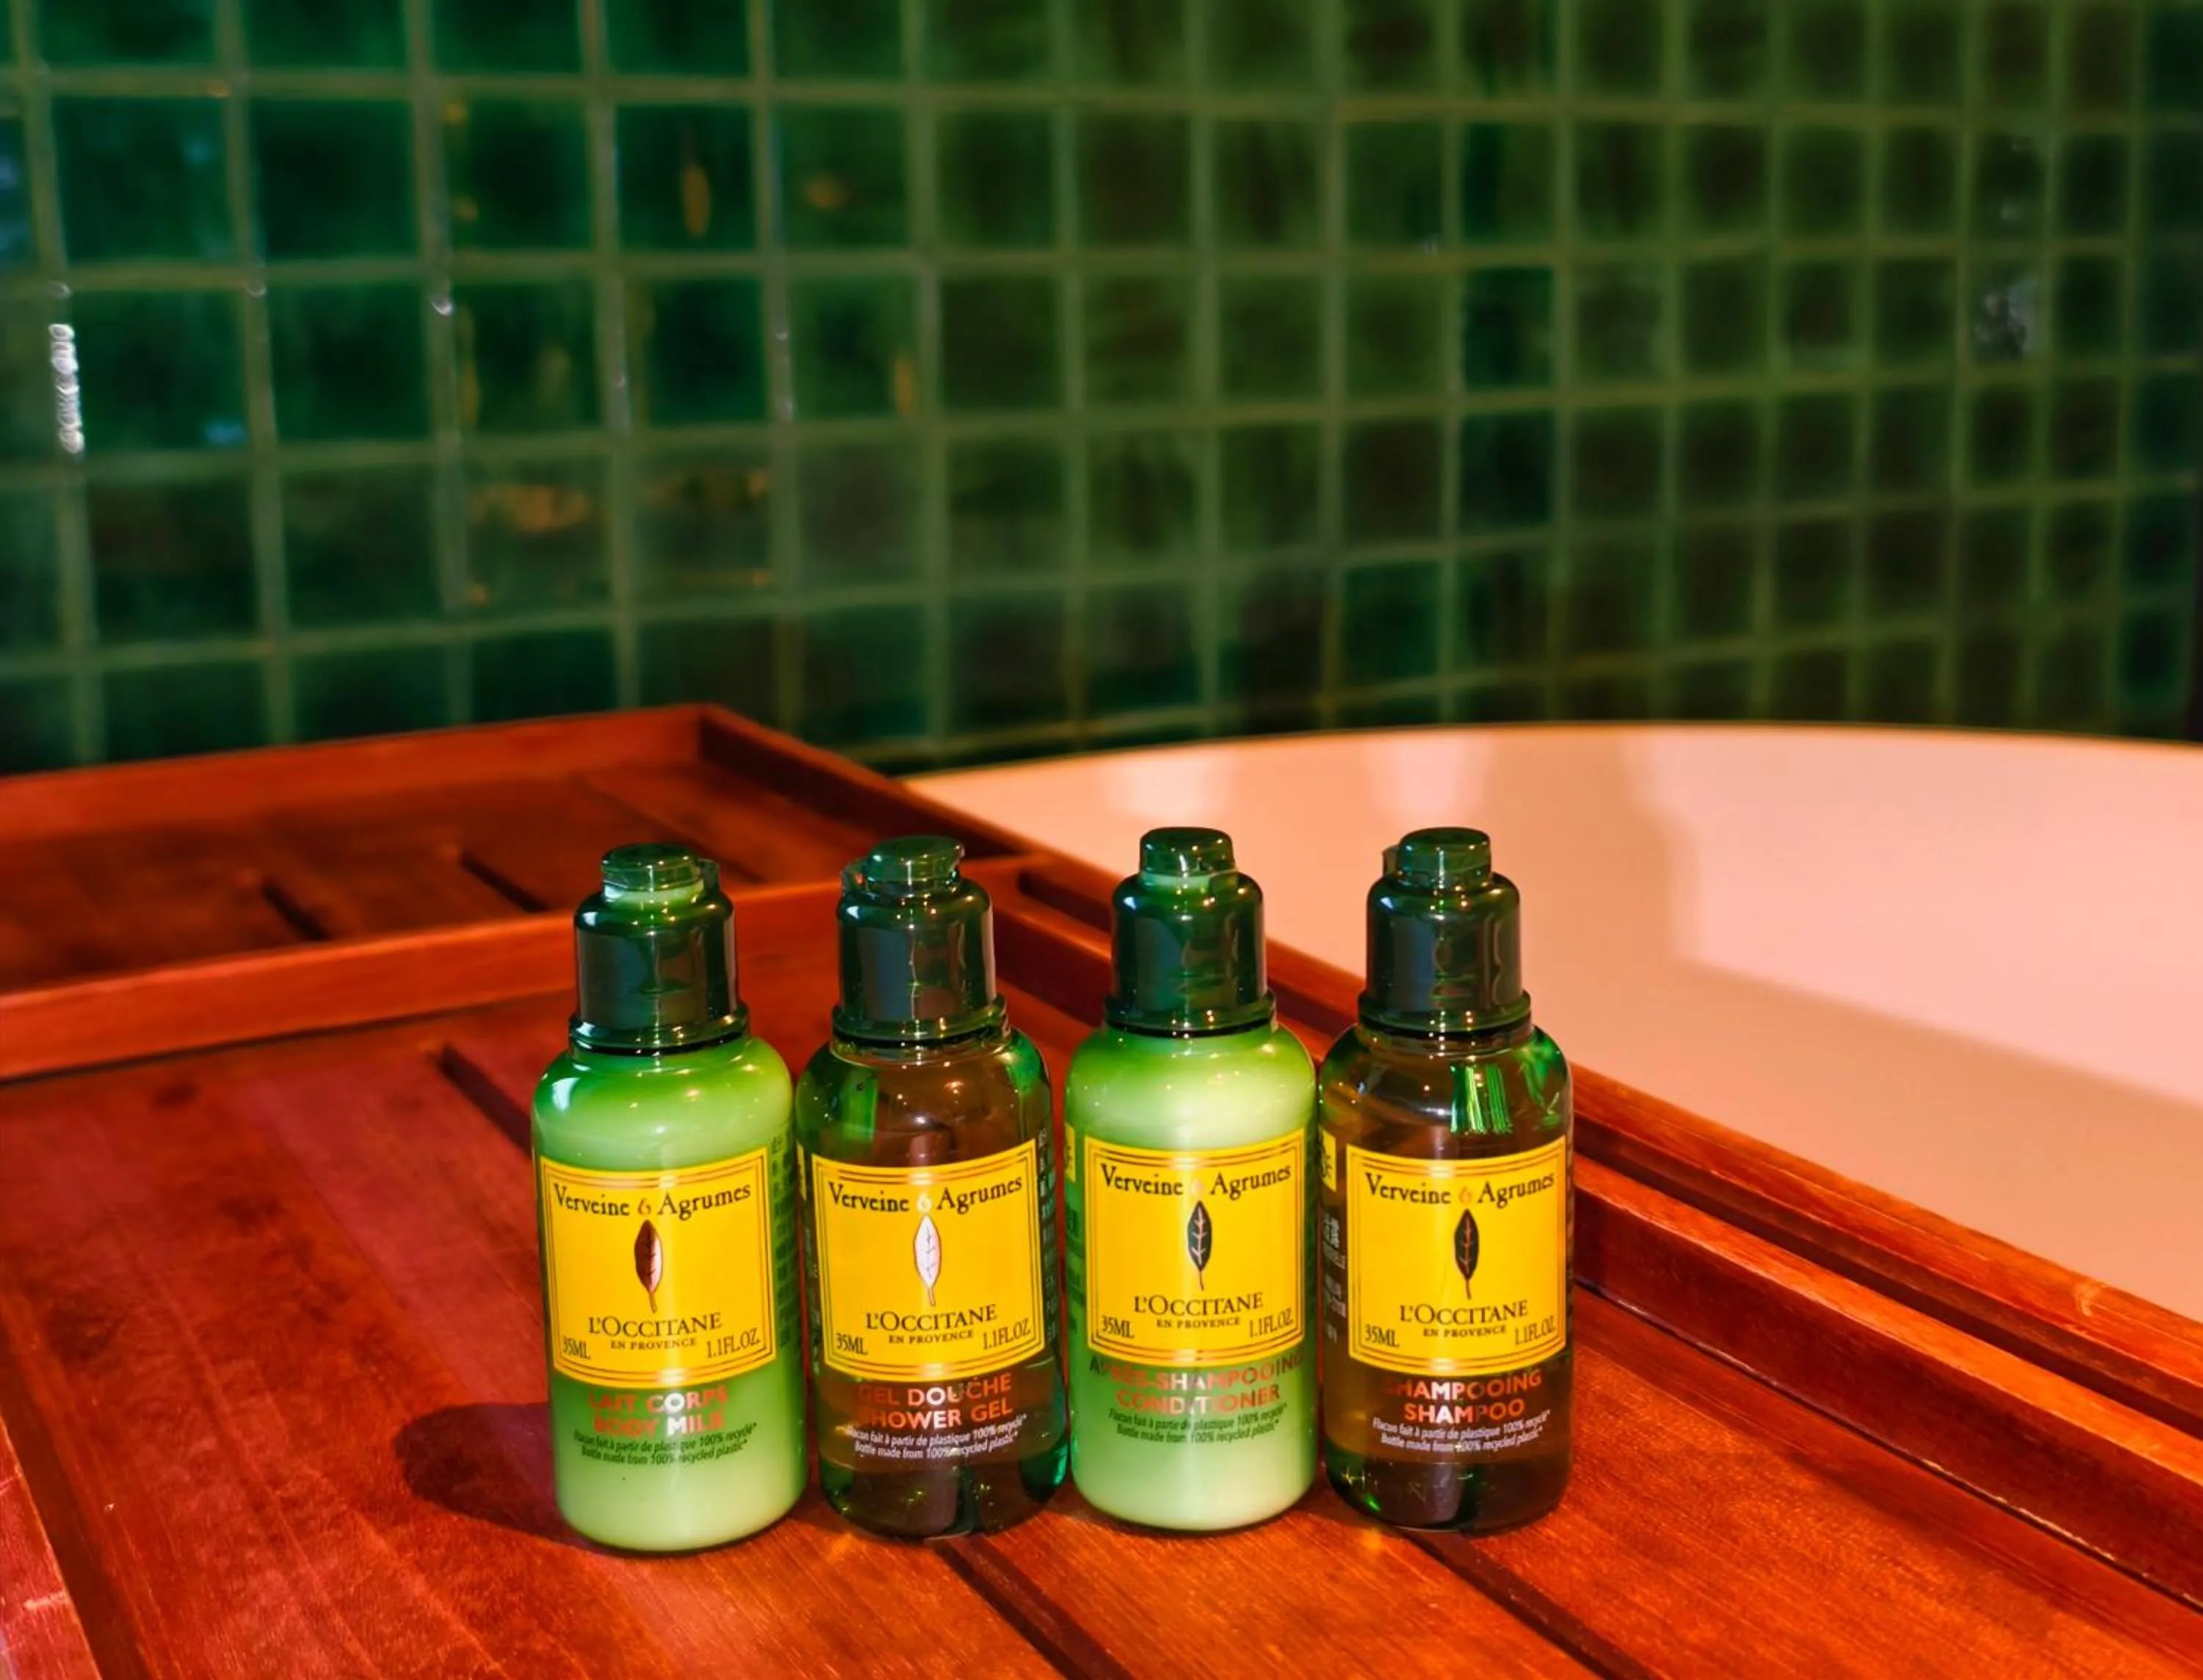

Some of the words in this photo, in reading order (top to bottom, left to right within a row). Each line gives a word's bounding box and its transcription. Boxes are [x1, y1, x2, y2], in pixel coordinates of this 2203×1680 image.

[1101, 1162, 1184, 1196] Verveine
[1210, 1165, 1292, 1201] Agrumes
[1365, 1172, 1451, 1204] Verveine
[1477, 1173, 1555, 1209] Agrumes
[553, 1183, 630, 1216] Verveine
[657, 1184, 751, 1220] Agrumes
[828, 1181, 910, 1212] Verveine
[937, 1176, 1023, 1214] Agrumes
[1134, 1292, 1264, 1317] L'OCCITANE
[1399, 1300, 1529, 1325] L'OCCITANE
[588, 1312, 723, 1338] L'OCCITANE
[865, 1304, 997, 1332] L'OCCITANE
[1102, 1315, 1135, 1339] 35ML
[1157, 1318, 1172, 1328] EN
[1176, 1316, 1241, 1328] PROVENCE
[611, 1340, 626, 1350] EN
[630, 1337, 698, 1350] PROVENCE
[836, 1333, 868, 1355] 35ML
[889, 1335, 904, 1344] EN
[908, 1330, 974, 1344] PROVENCE
[1364, 1324, 1400, 1347] 35ML
[1423, 1328, 1439, 1337] EN
[1444, 1325, 1507, 1338] PROVENCE
[562, 1336, 591, 1360] 35ML
[858, 1384, 900, 1405] GEL
[908, 1373, 1012, 1406] DOUCHE
[1386, 1369, 1542, 1400] HAMPOOING
[589, 1391, 637, 1413] LAIT
[646, 1385, 728, 1413] CORPS
[1116, 1384, 1280, 1414] CONDITONER
[1404, 1398, 1525, 1424] SHAMPOO
[594, 1416, 659, 1438] BODY
[667, 1411, 723, 1435] MILK
[858, 1408, 963, 1430] HOWER
[970, 1397, 1013, 1422] GEL
[654, 1438, 696, 1453] plastque
[951, 1439, 988, 1458] cycled
